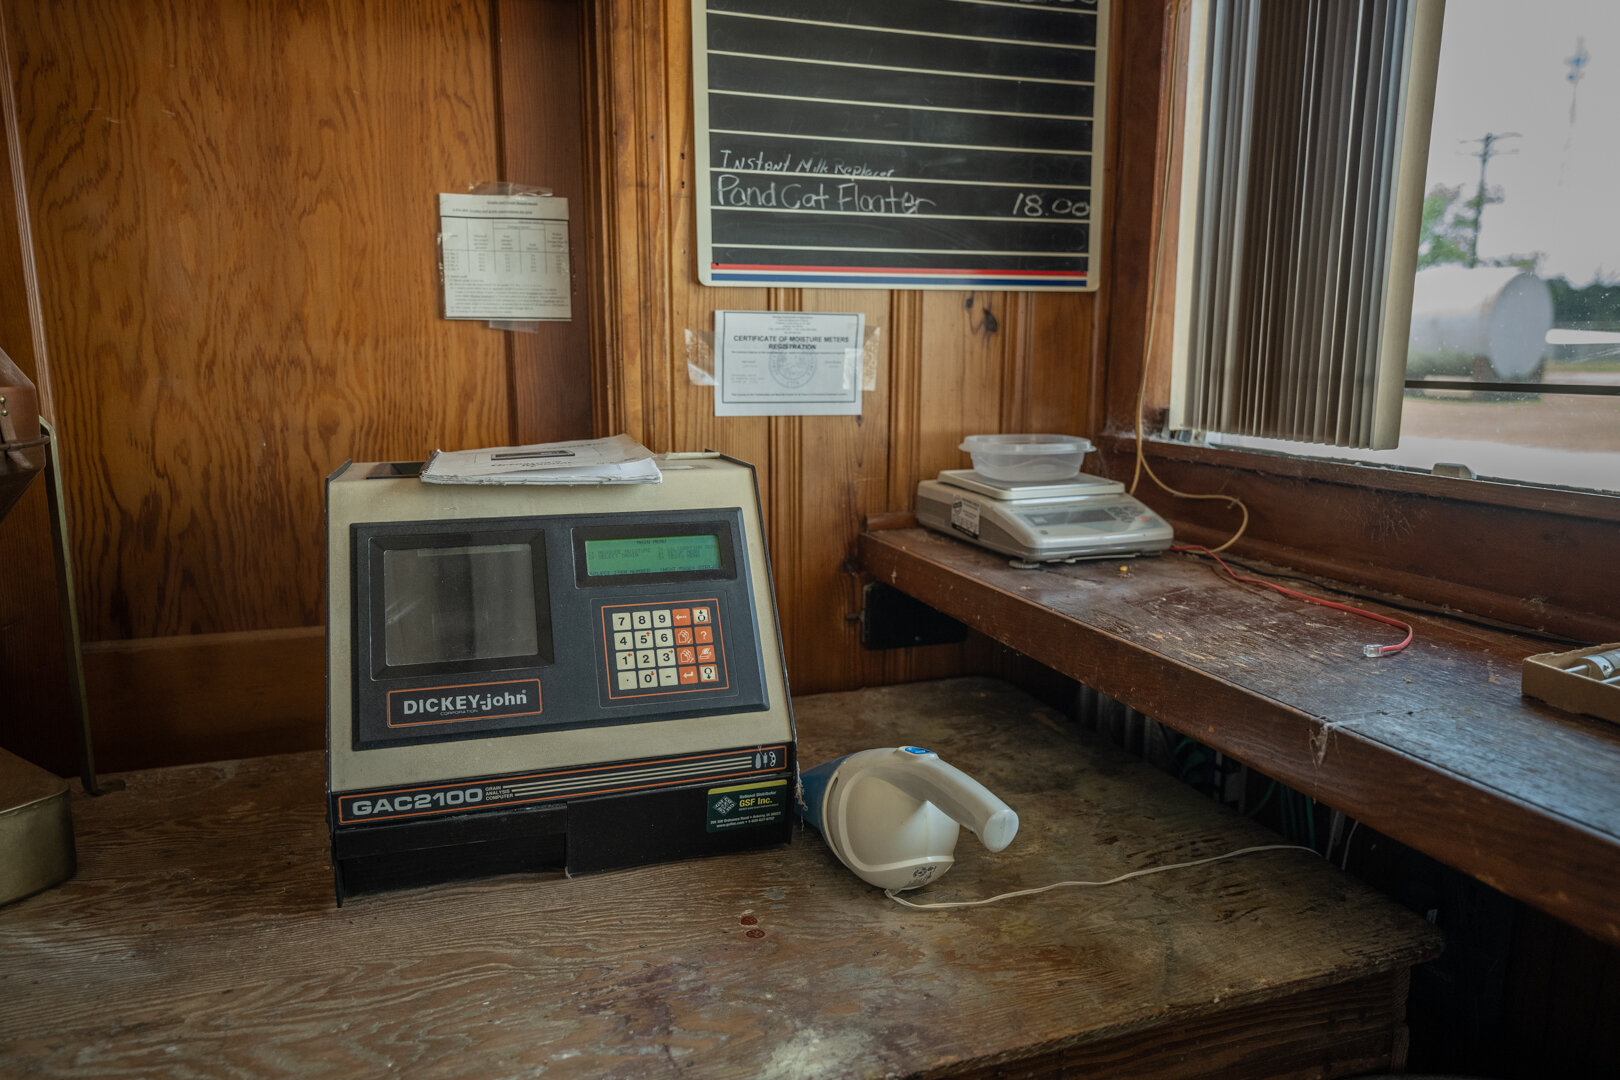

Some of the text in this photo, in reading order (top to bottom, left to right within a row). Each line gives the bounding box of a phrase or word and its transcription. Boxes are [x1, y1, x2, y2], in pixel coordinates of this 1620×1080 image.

[796, 158, 828, 173] Milk
[781, 183, 829, 209] Cat
[1013, 192, 1090, 217] 18.00
[618, 617, 625, 626] 7
[638, 616, 646, 624] 8
[658, 614, 666, 623] 9
[620, 637, 627, 645] 4
[640, 635, 647, 644] 5
[661, 633, 668, 642] 6
[622, 656, 628, 665] 1
[642, 655, 650, 663] 2
[663, 653, 670, 661] 3
[644, 674, 652, 683] 0
[403, 691, 527, 715] DICKEY-john
[352, 788, 483, 816] GAC2100
[739, 798, 755, 807] GSF
[757, 797, 773, 805] Inc.
